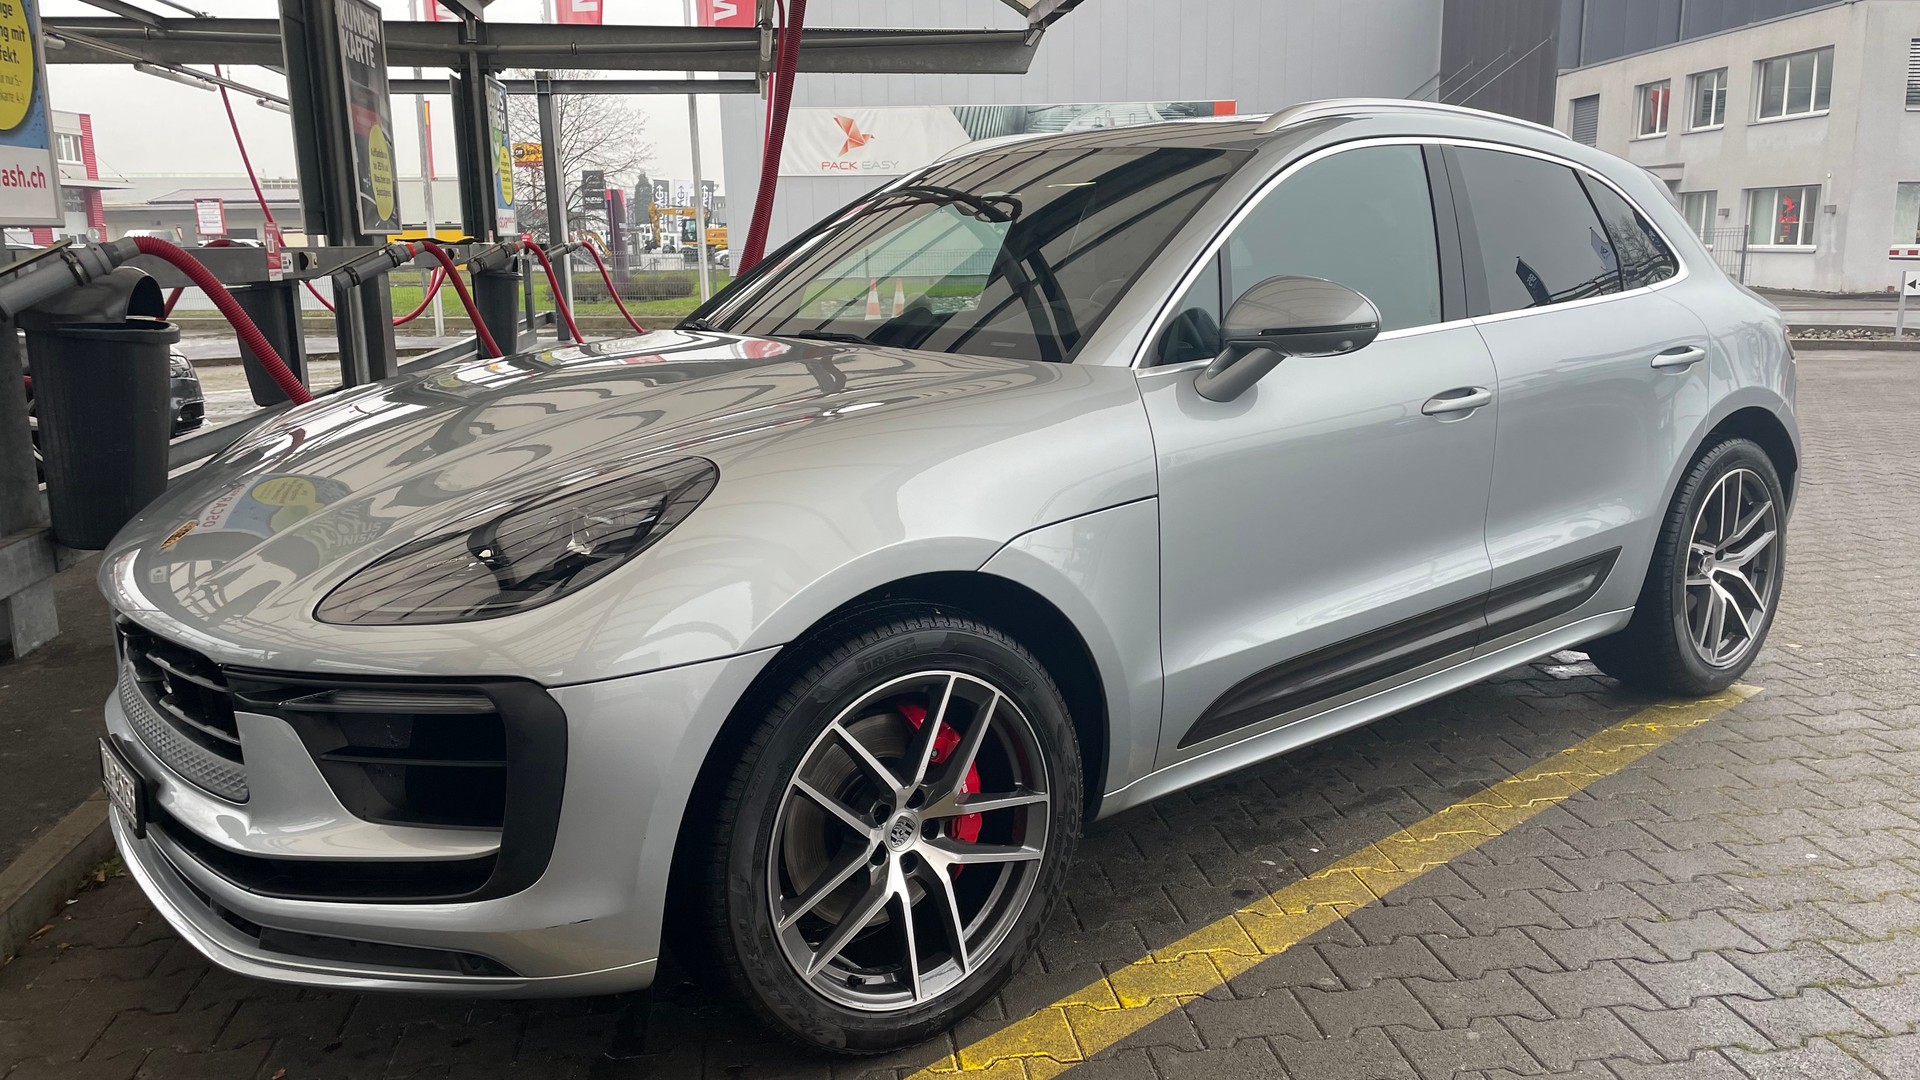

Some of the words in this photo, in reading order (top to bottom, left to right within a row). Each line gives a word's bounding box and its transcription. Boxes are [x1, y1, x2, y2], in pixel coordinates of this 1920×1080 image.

[11, 25, 26, 42] mit
[341, 0, 381, 44] KUNDEN
[345, 30, 376, 69] KARTE
[0, 164, 47, 189] ash.ch
[821, 161, 858, 170] PACK
[862, 160, 900, 170] EASY
